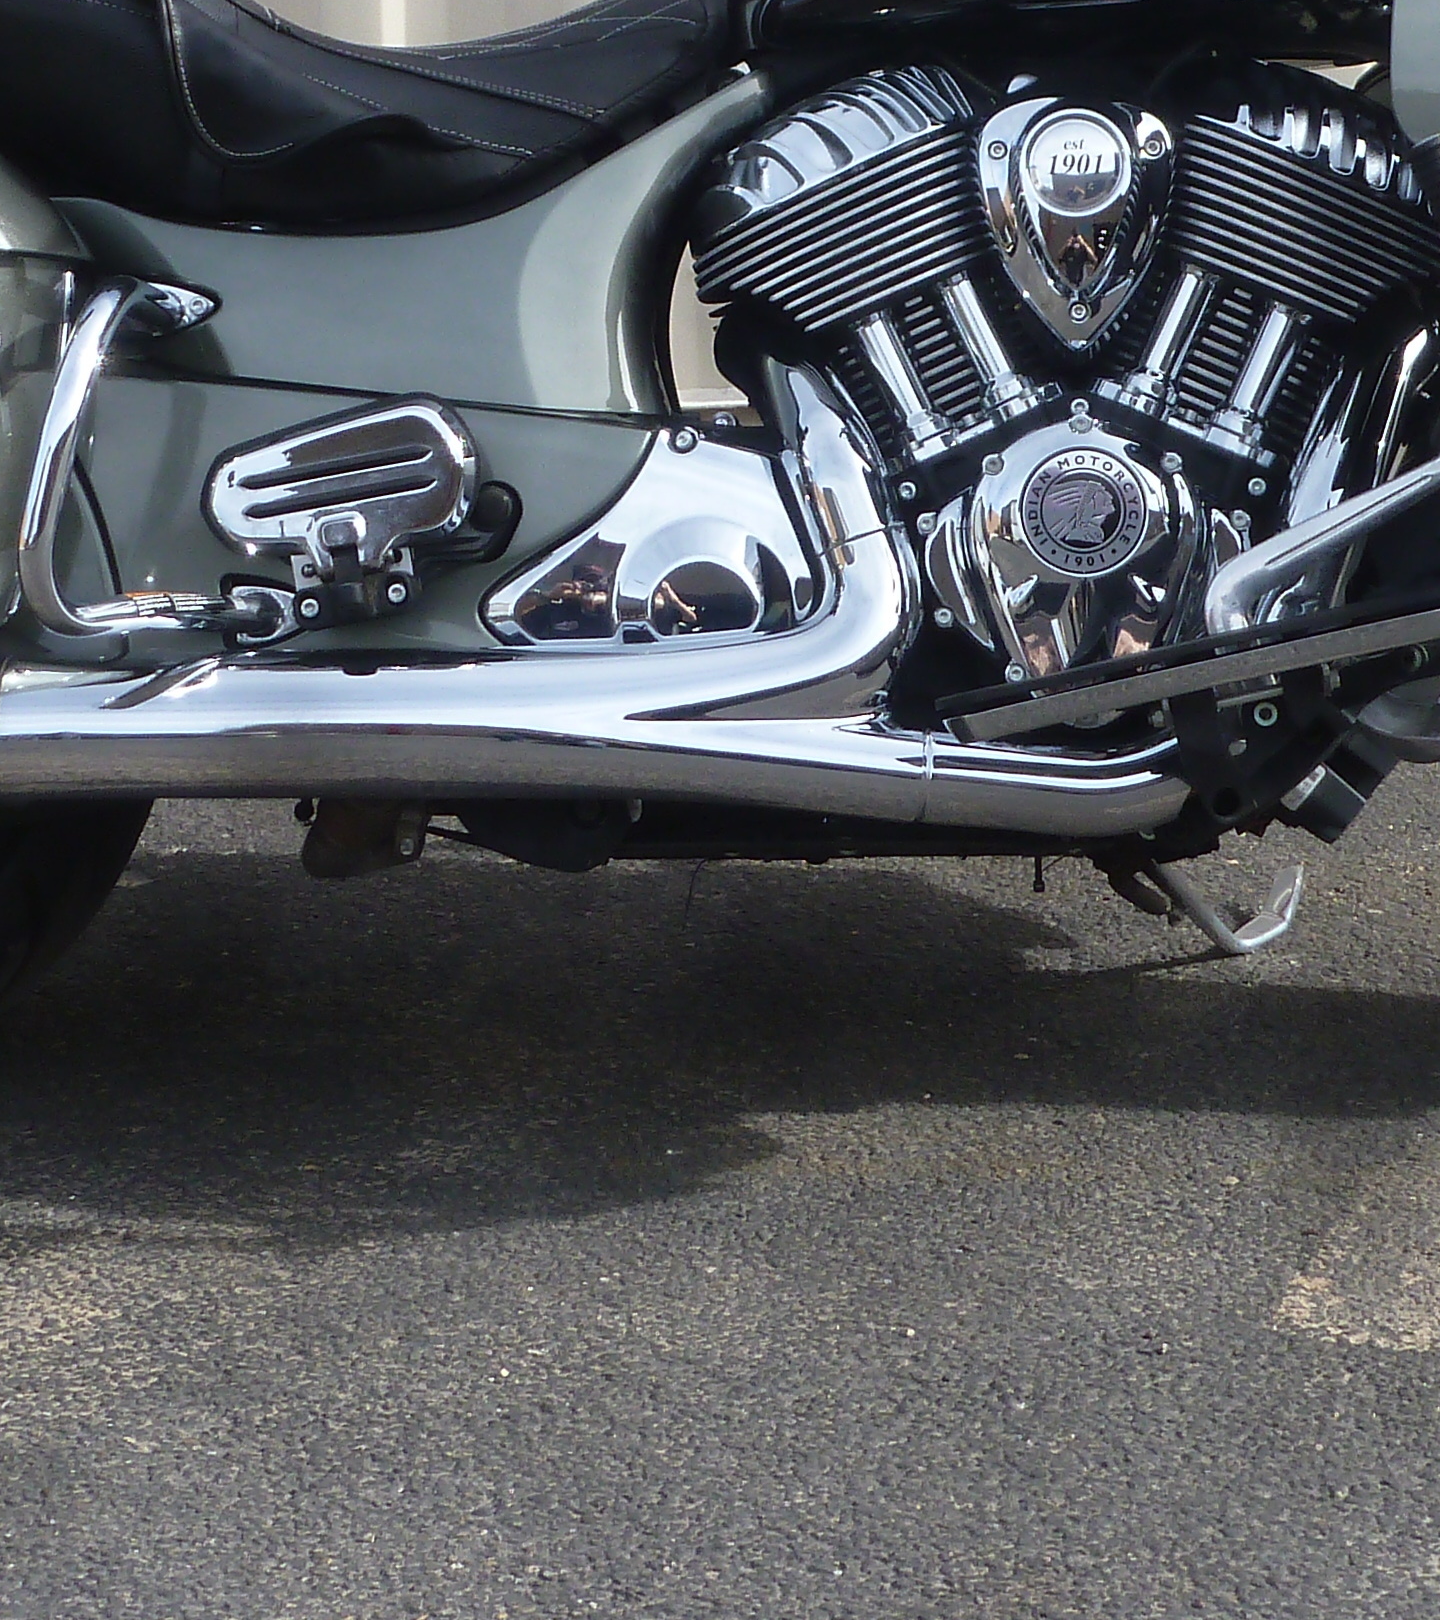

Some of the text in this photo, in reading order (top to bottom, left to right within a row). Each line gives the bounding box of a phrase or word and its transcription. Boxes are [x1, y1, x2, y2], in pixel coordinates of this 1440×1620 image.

[1063, 138, 1086, 151] est
[1048, 153, 1104, 176] 1901
[1027, 454, 1138, 546] INDIAN MOTORCYCLE
[1064, 552, 1106, 567] 1901
